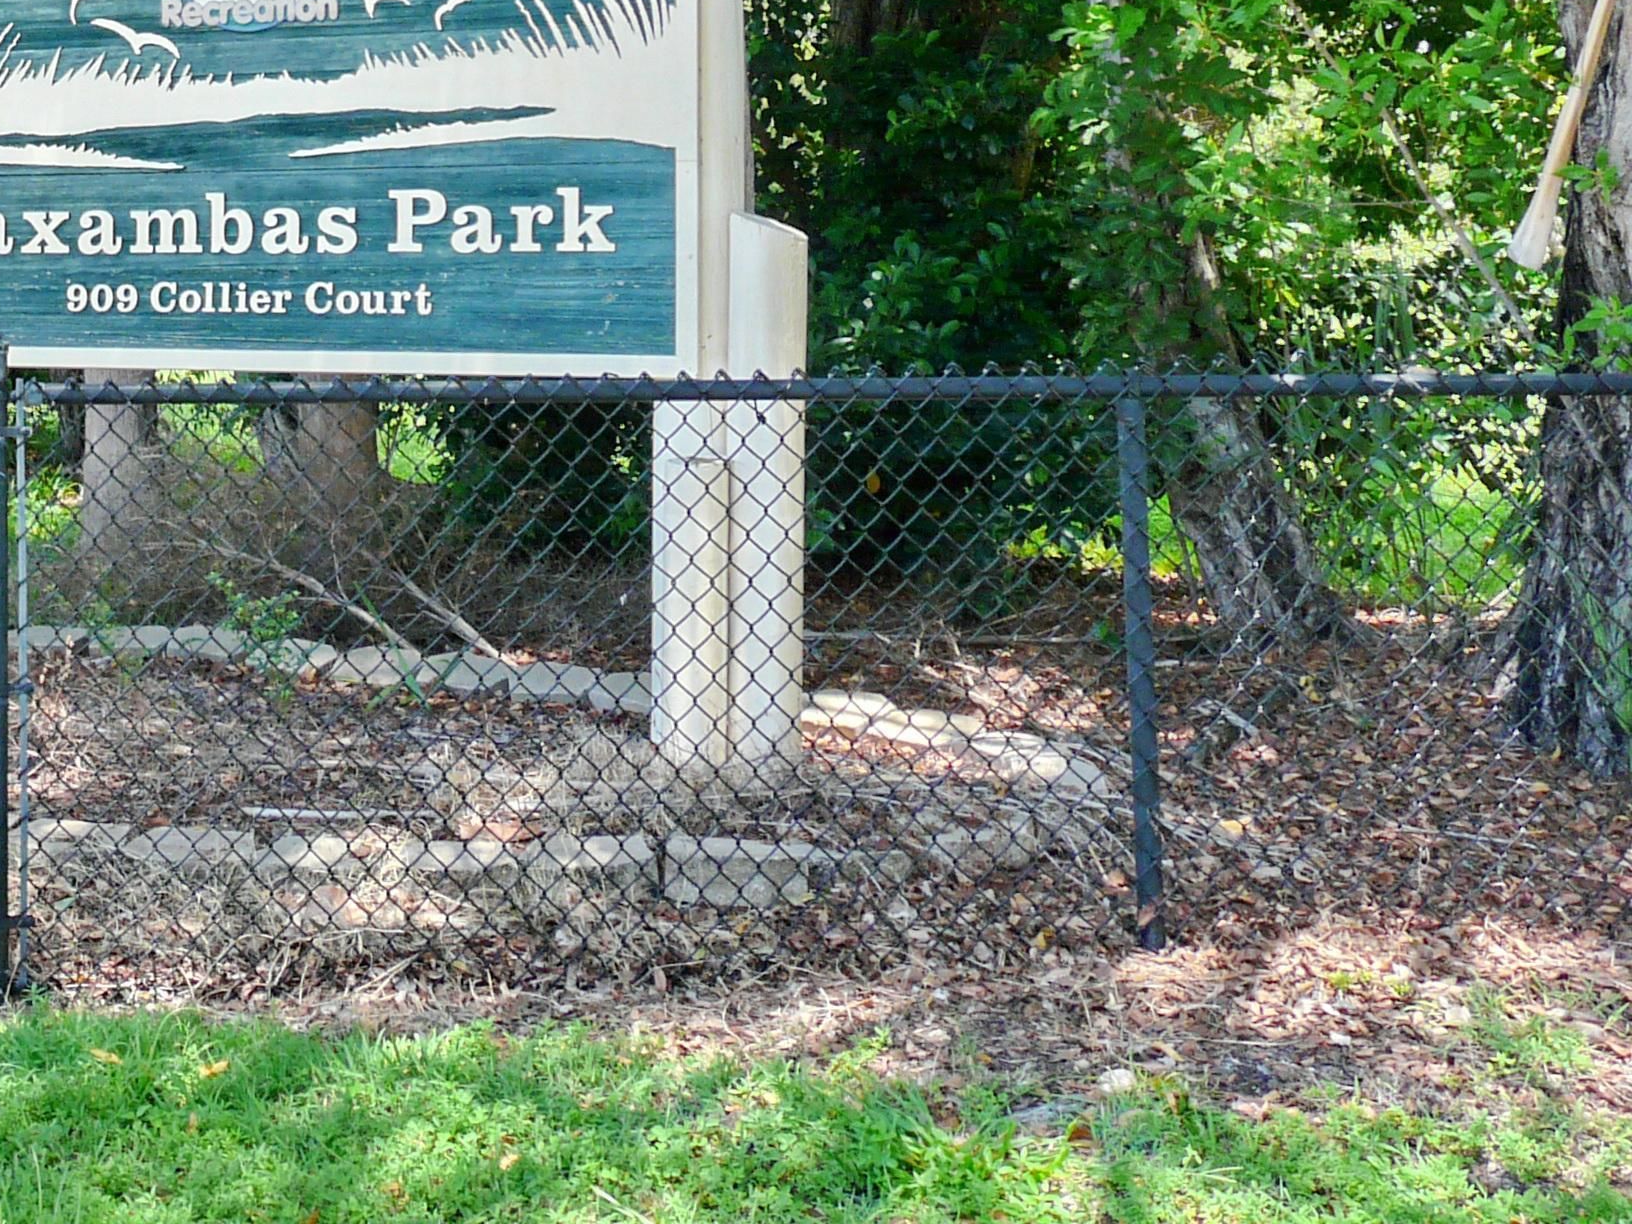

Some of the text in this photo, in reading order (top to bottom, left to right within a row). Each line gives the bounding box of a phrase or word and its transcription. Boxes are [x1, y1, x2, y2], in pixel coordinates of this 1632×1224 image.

[387, 187, 617, 254] Park
[66, 281, 433, 316] 909 Collier Court
